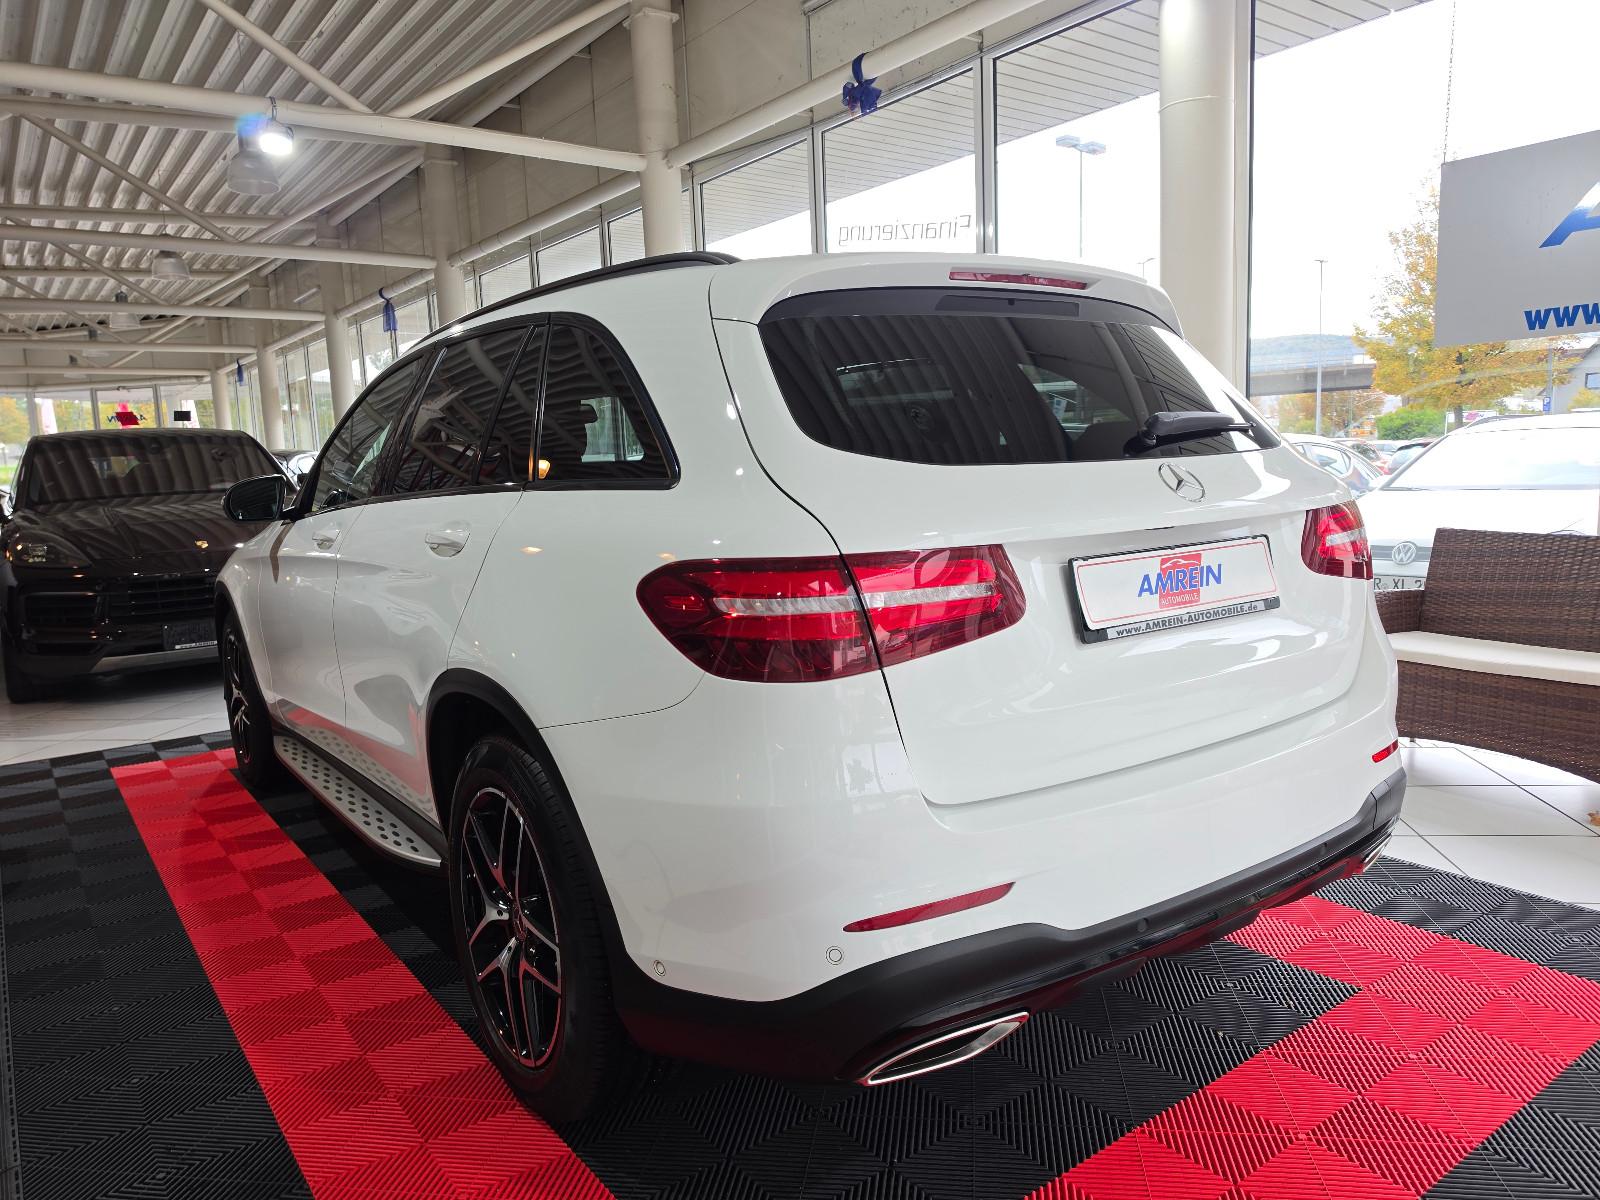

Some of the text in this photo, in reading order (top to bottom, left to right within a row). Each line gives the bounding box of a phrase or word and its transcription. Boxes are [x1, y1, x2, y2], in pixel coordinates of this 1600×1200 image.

[1137, 563, 1222, 598] AMREIN
[1161, 592, 1199, 605] AUTOMOBILE
[1115, 603, 1258, 637] www.AMREIN-AUTOMOBILE.de
